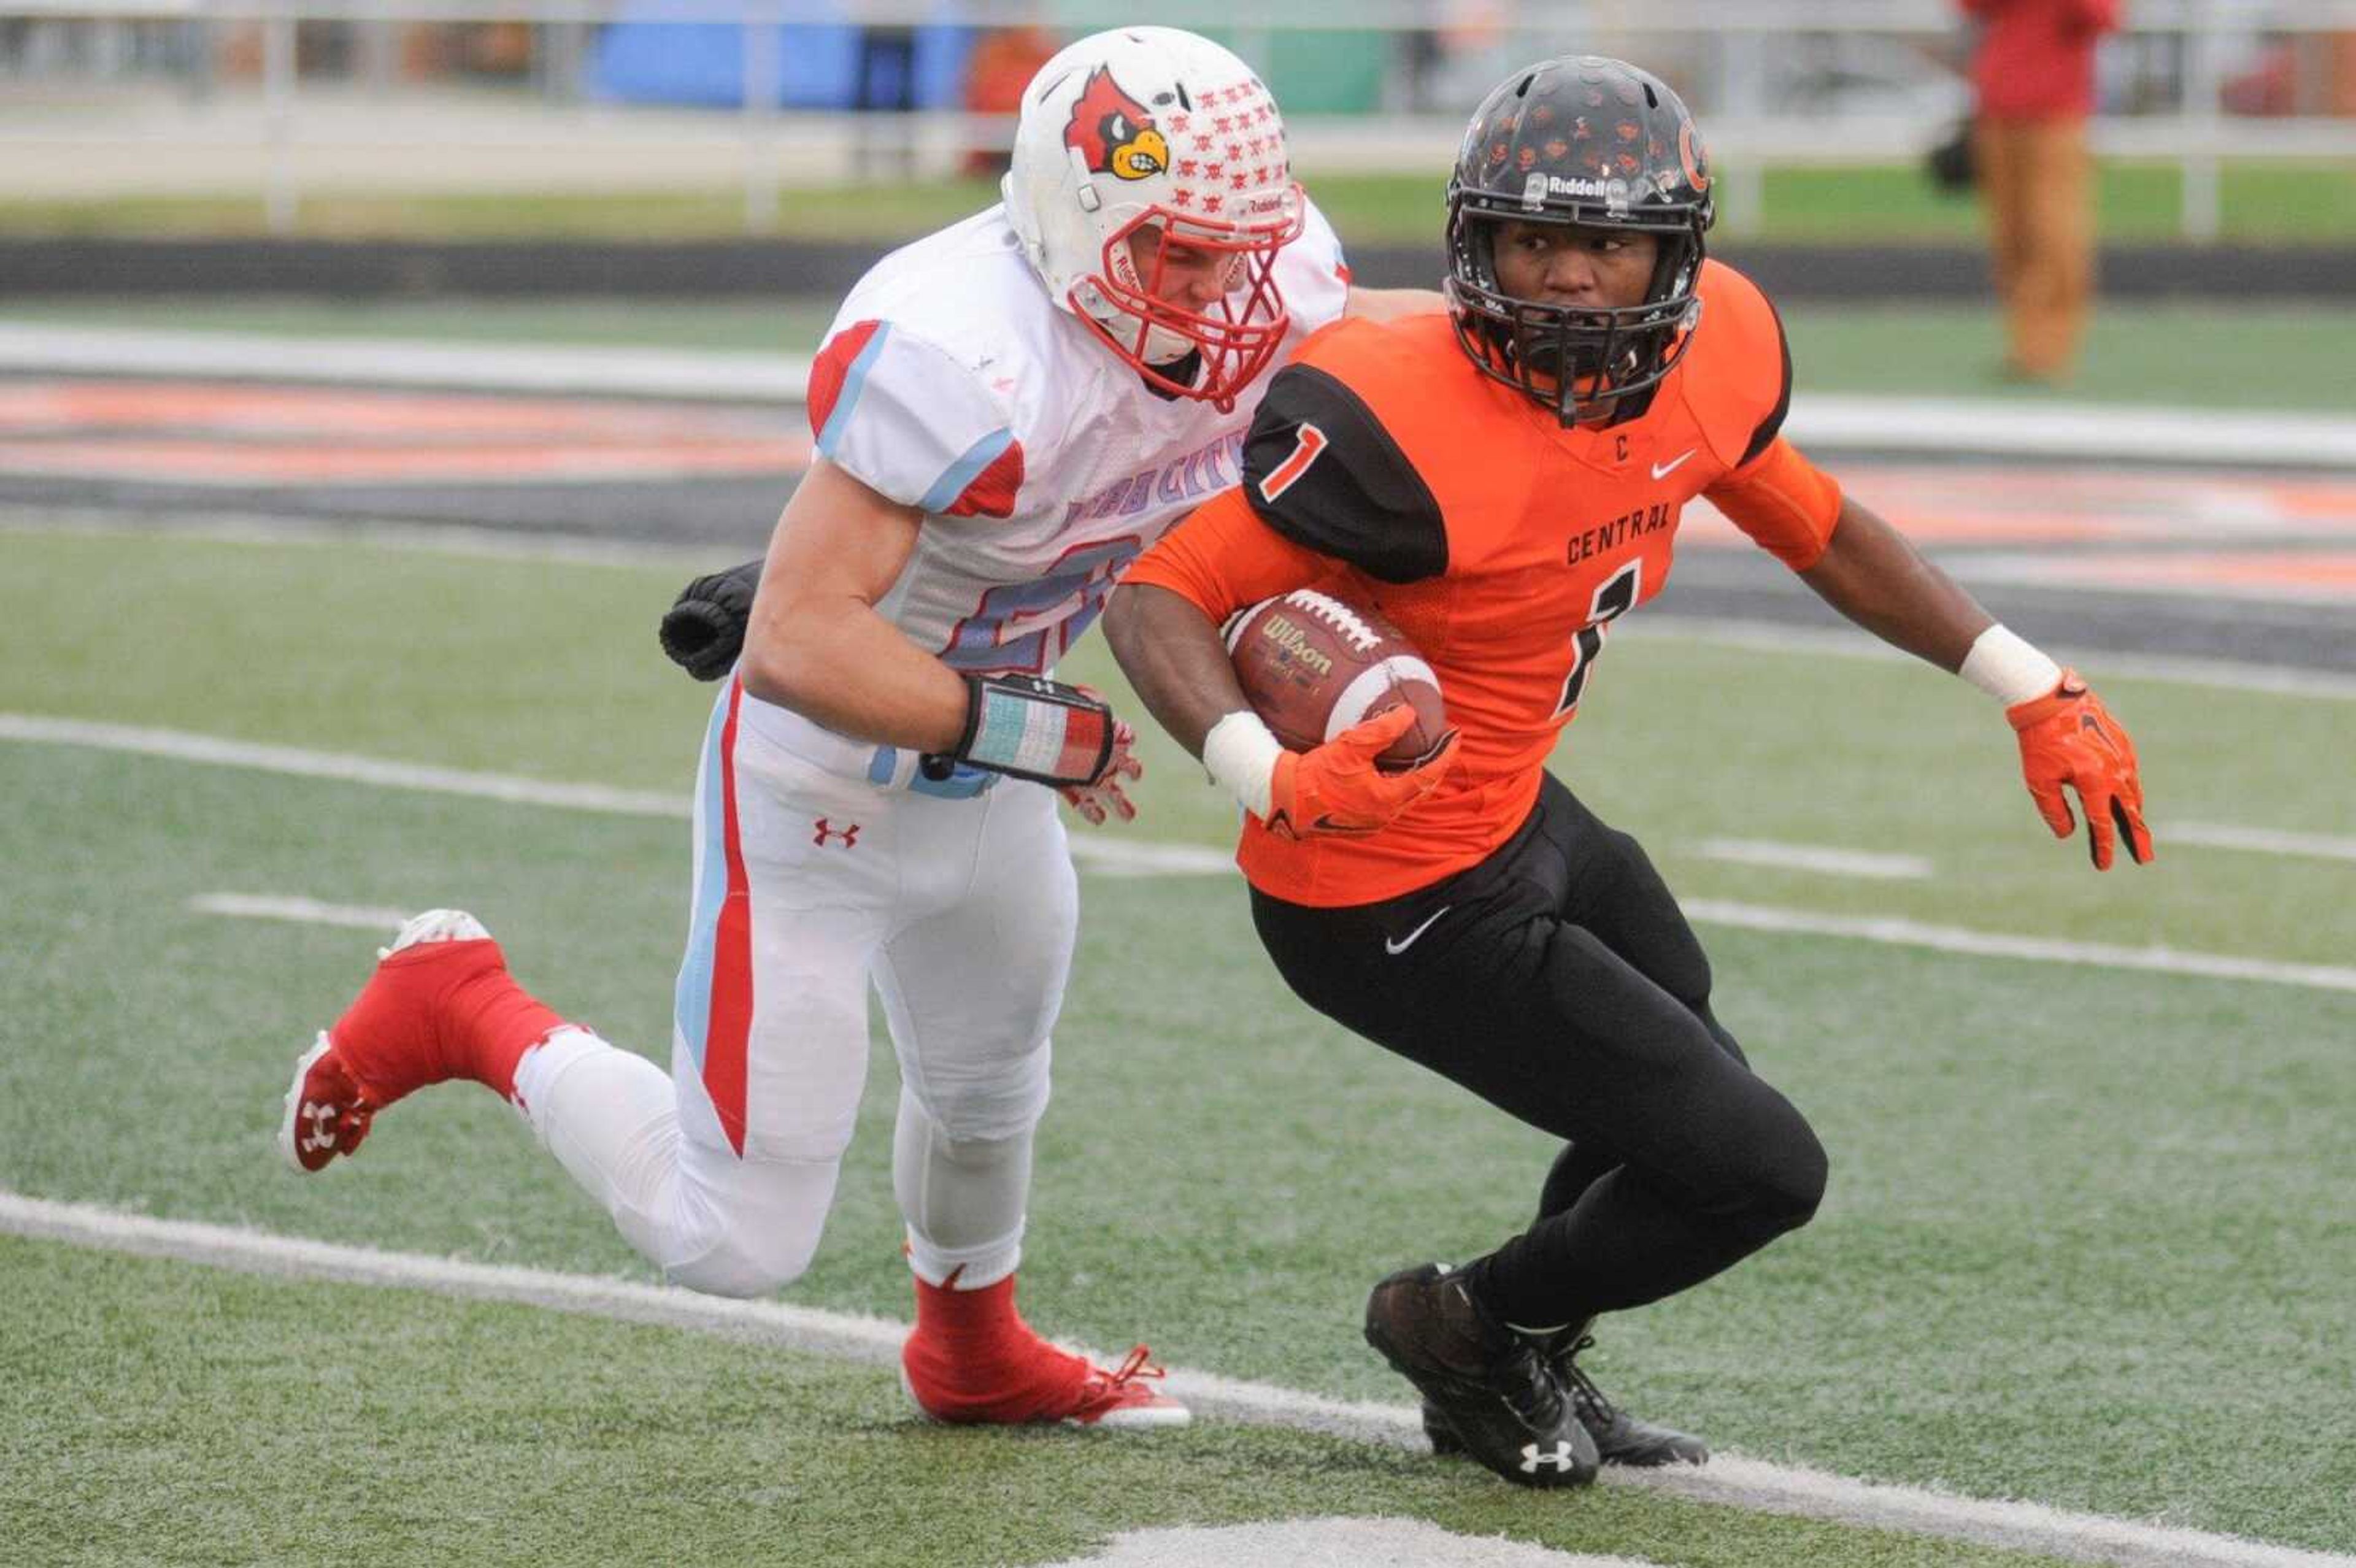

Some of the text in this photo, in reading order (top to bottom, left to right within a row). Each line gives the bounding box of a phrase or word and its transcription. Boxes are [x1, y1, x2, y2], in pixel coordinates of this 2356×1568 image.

[1548, 175, 1605, 196] Riddell
[1259, 422, 1329, 504] 1
[1615, 435, 1628, 461] C
[1567, 502, 1669, 566] CENTRAL
[1262, 614, 1333, 675] Wilson
[1550, 556, 1642, 721] 1
